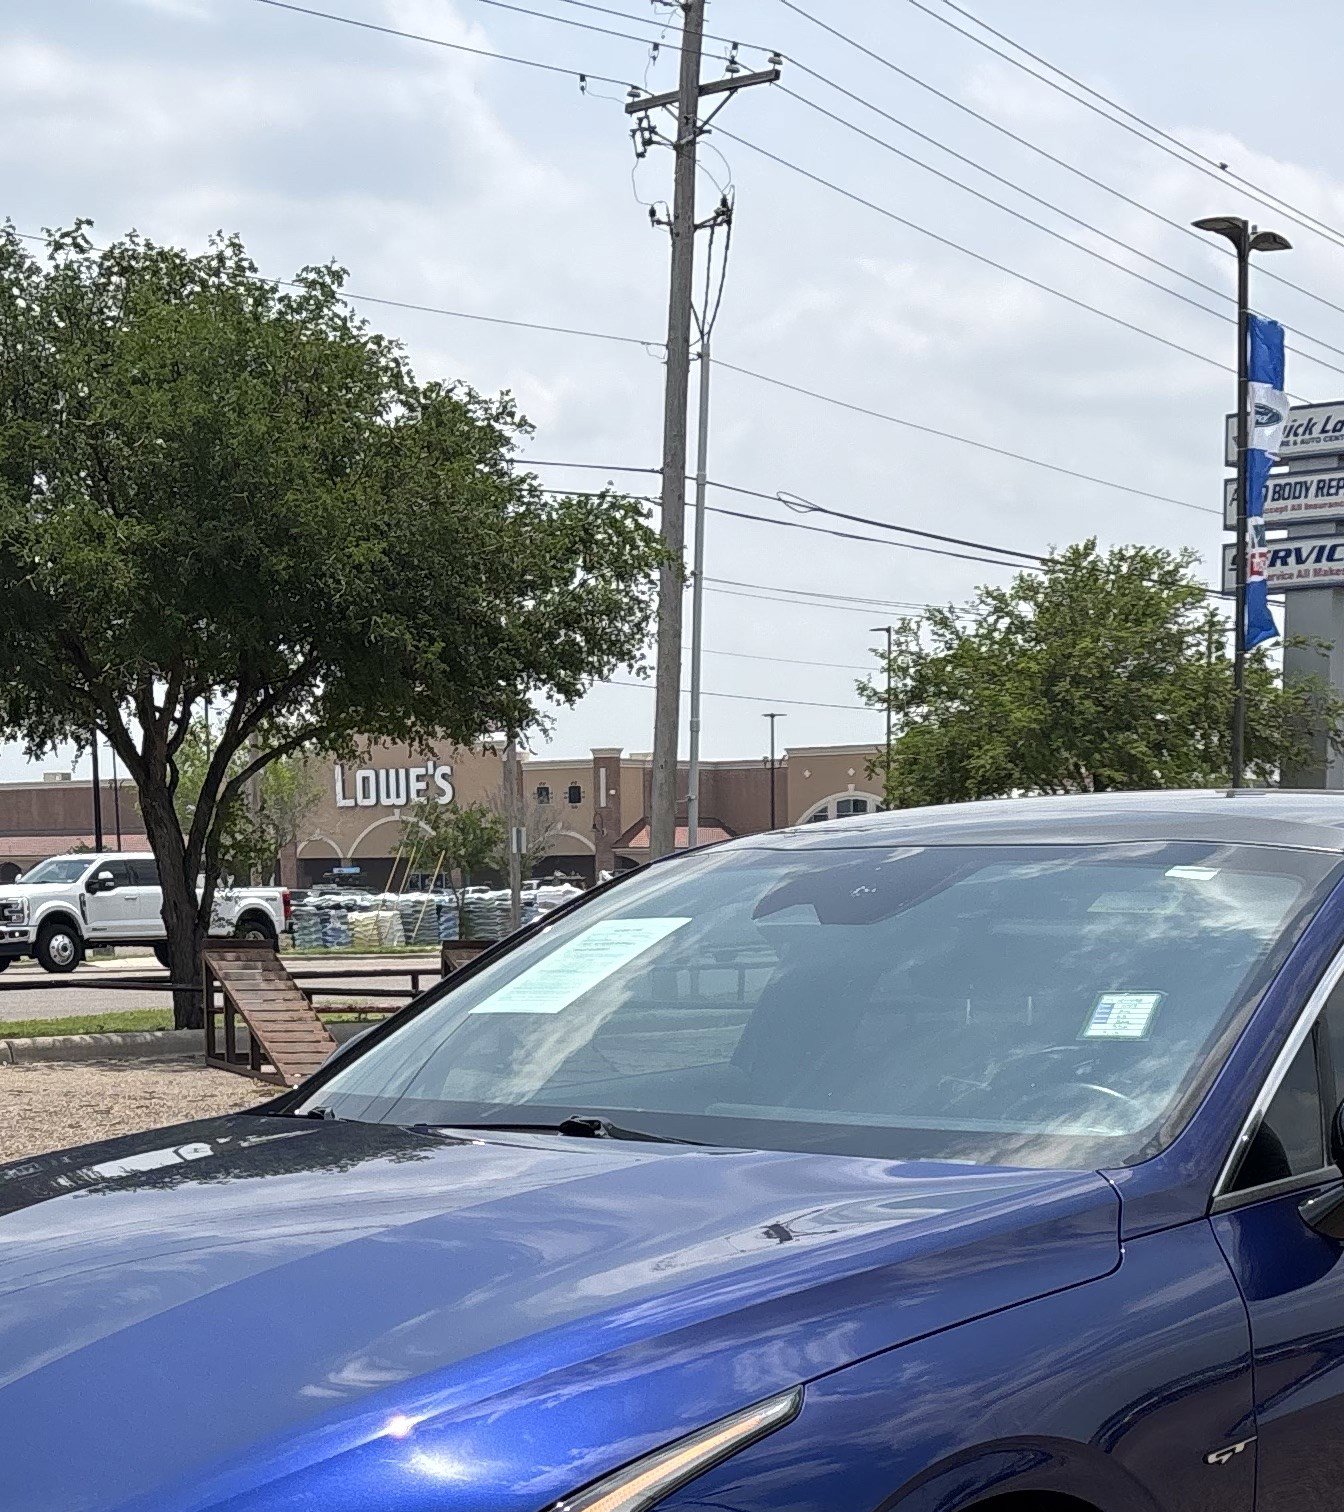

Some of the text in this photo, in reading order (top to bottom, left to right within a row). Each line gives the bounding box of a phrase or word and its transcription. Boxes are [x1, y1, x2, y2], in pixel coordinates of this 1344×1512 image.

[1271, 480, 1315, 502] BODY
[1263, 505, 1289, 515] ccept
[1267, 571, 1294, 581] ervice
[335, 760, 453, 807] LOWE'S
